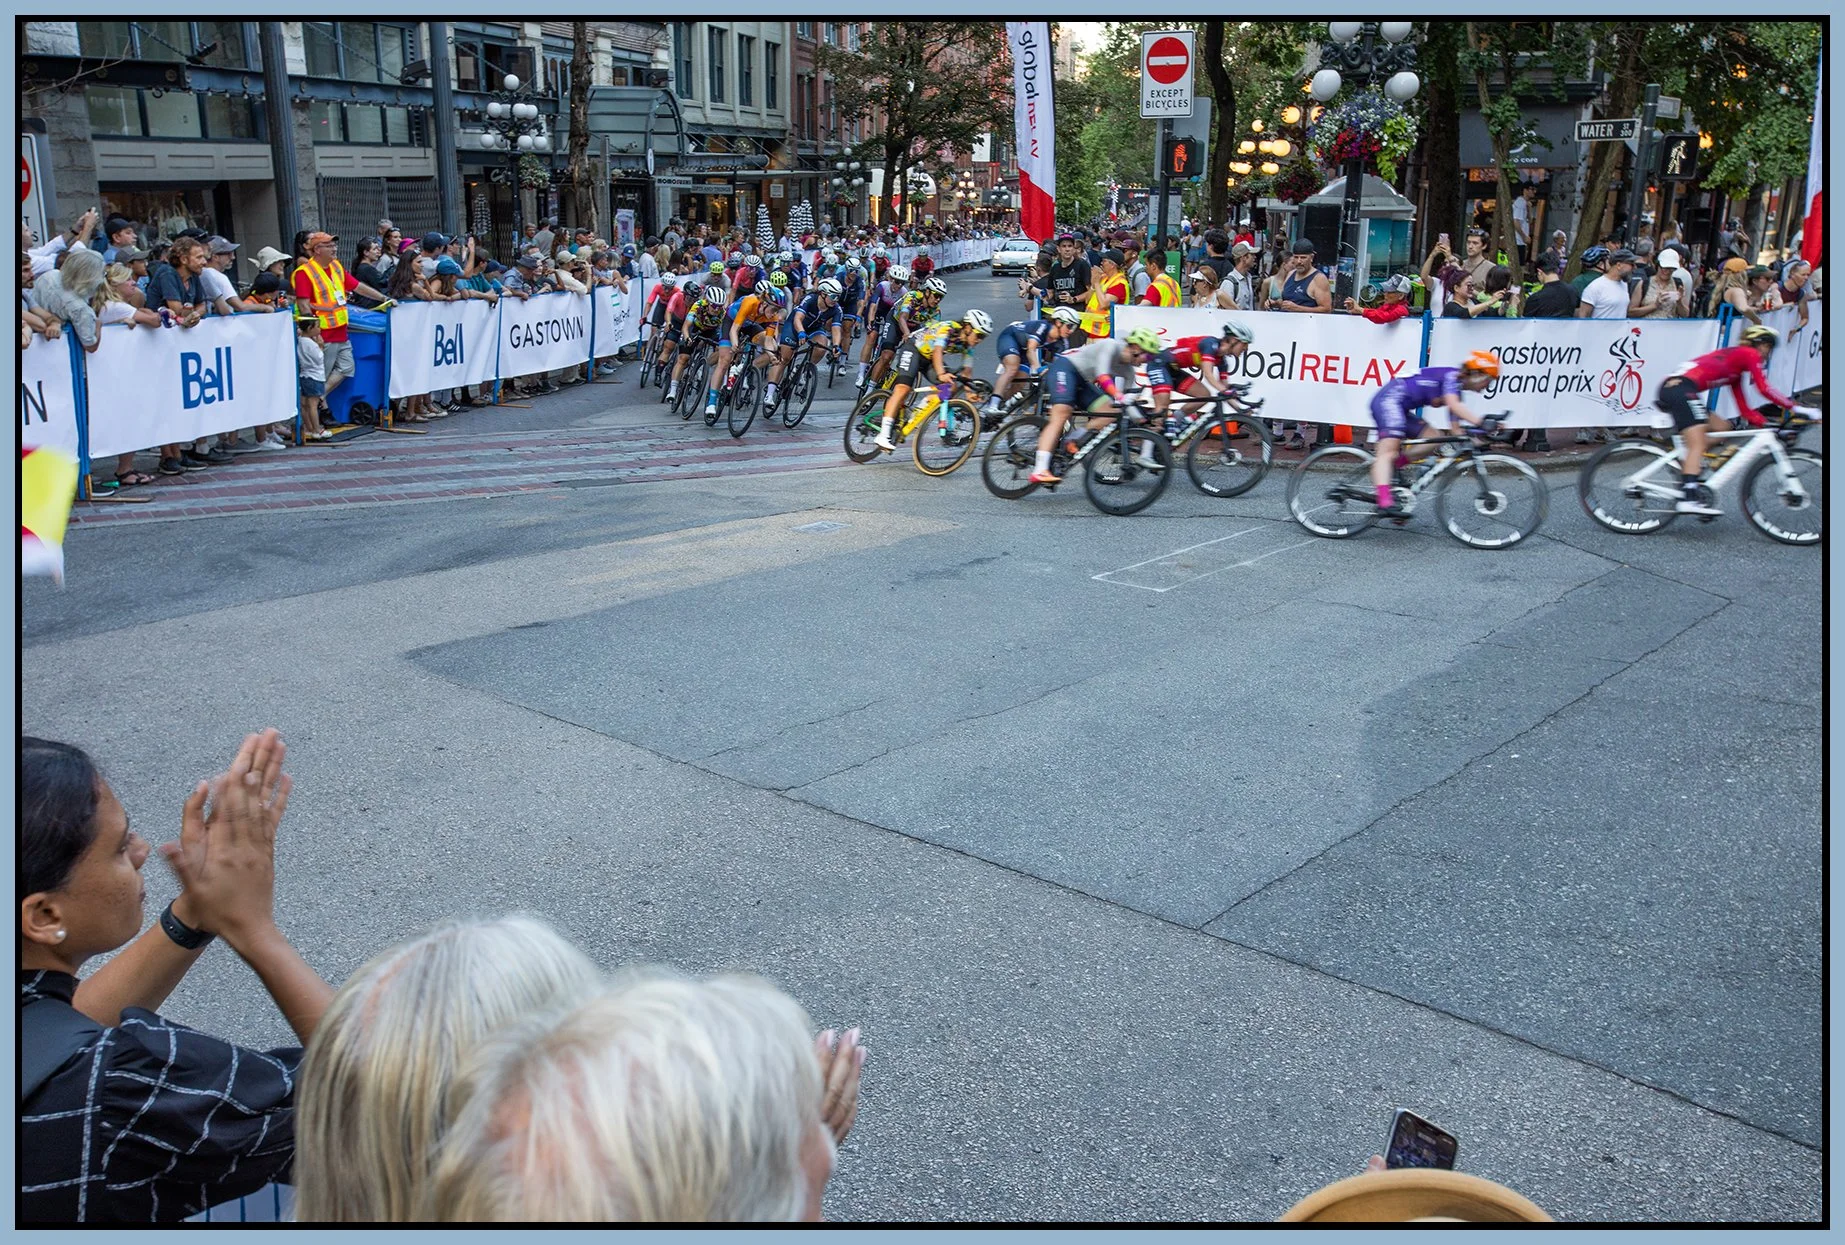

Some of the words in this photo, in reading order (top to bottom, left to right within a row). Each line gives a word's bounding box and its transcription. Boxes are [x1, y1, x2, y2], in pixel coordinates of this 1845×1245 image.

[1145, 99, 1189, 109] BICYCLES
[1150, 89, 1184, 98] EXCEPT
[1580, 123, 1615, 138] WATER
[433, 322, 464, 367] Bell
[509, 315, 584, 349] GASTOWN
[180, 346, 234, 410] Bell
[1483, 368, 1552, 400] grand
[1553, 370, 1596, 399] prix
